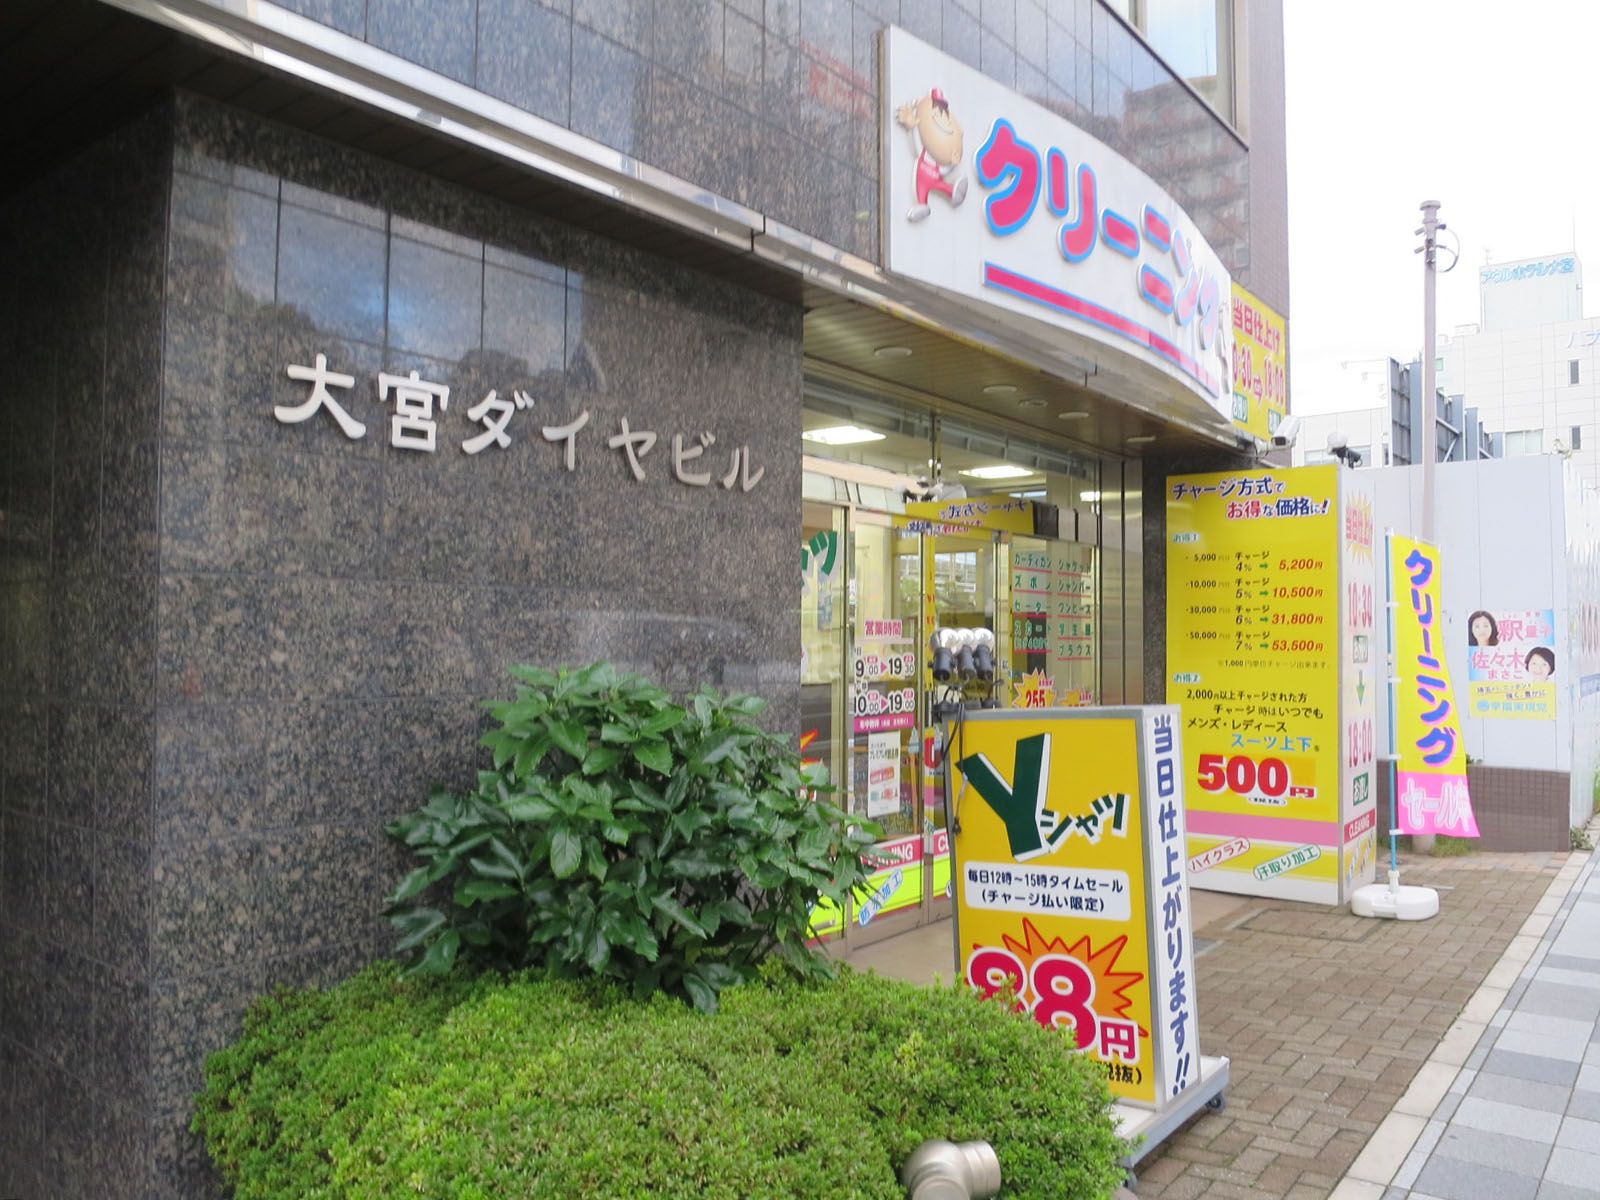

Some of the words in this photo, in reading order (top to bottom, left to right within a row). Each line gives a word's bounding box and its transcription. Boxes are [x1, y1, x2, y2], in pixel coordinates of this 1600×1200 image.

[274, 353, 764, 492] 大宮ダイヤビル
[1173, 477, 1284, 500] チャージ方式で
[1279, 559, 1323, 571] 5,200円
[1273, 586, 1323, 598] 10,500円
[1271, 613, 1323, 625] 31,800円
[1271, 639, 1324, 652] 53,500円
[1405, 549, 1456, 766] クリーニング
[1188, 717, 1287, 732] メンズ・レディース
[1198, 753, 1315, 798] 500円
[955, 732, 1127, 858] Yシャツ
[1192, 840, 1248, 870] ハイクラス
